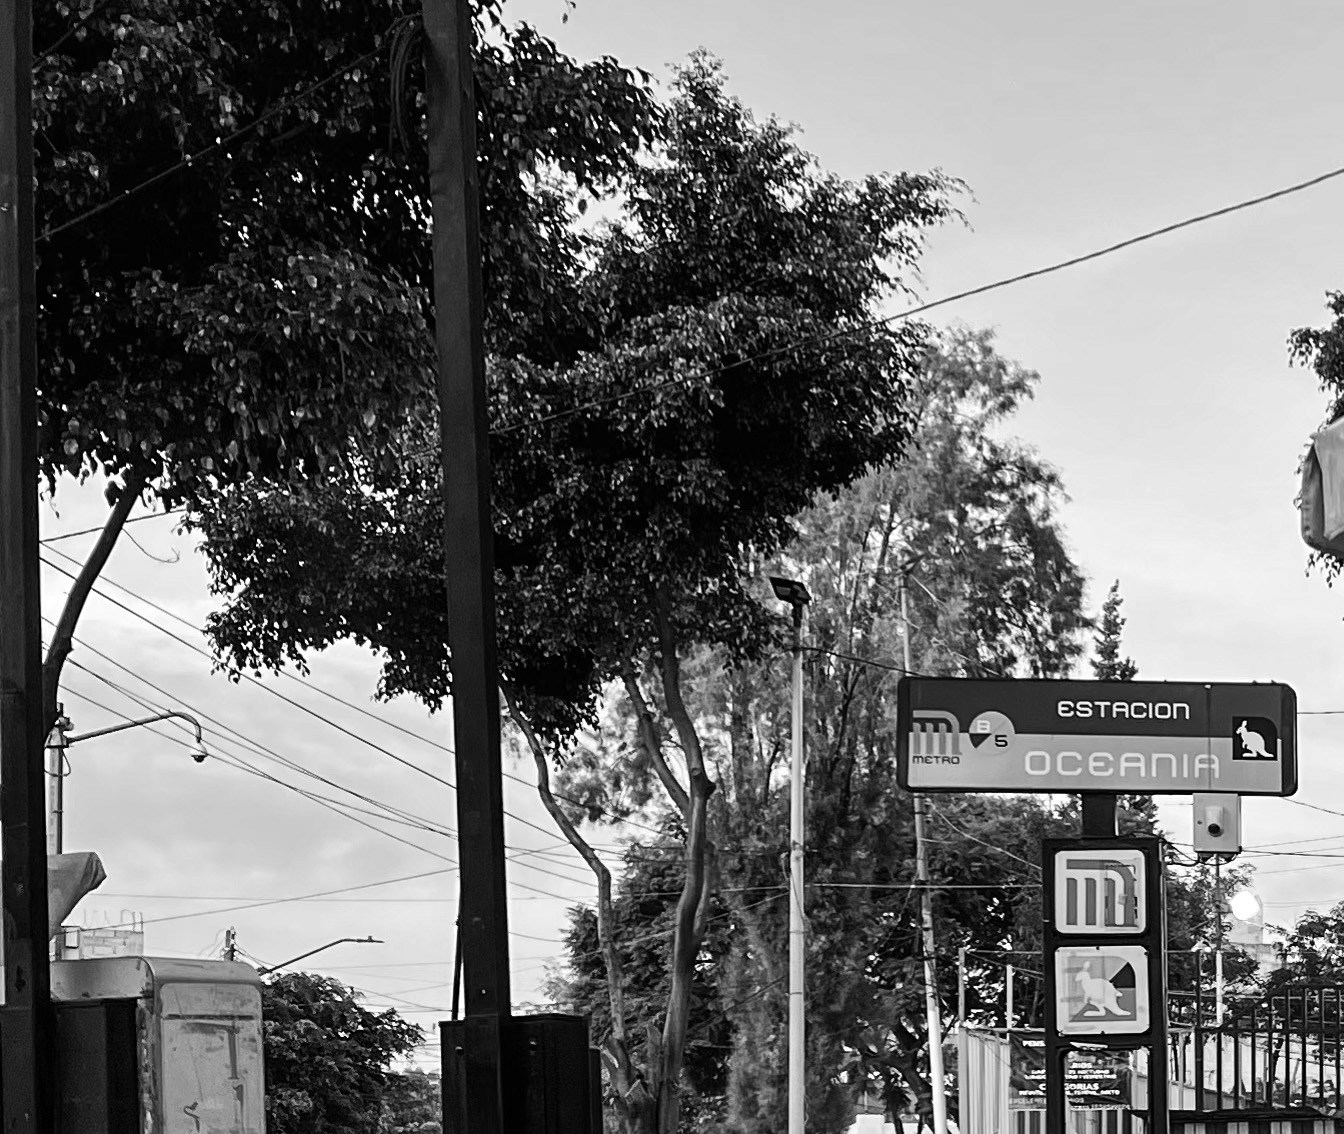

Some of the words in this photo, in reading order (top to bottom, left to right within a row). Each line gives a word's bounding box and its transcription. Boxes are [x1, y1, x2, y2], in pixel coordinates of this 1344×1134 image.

[1057, 700, 1191, 721] ESTACION
[976, 719, 991, 733] B
[994, 734, 1009, 748] 5
[911, 755, 961, 765] METRO
[1023, 750, 1221, 779] OCEANIA
